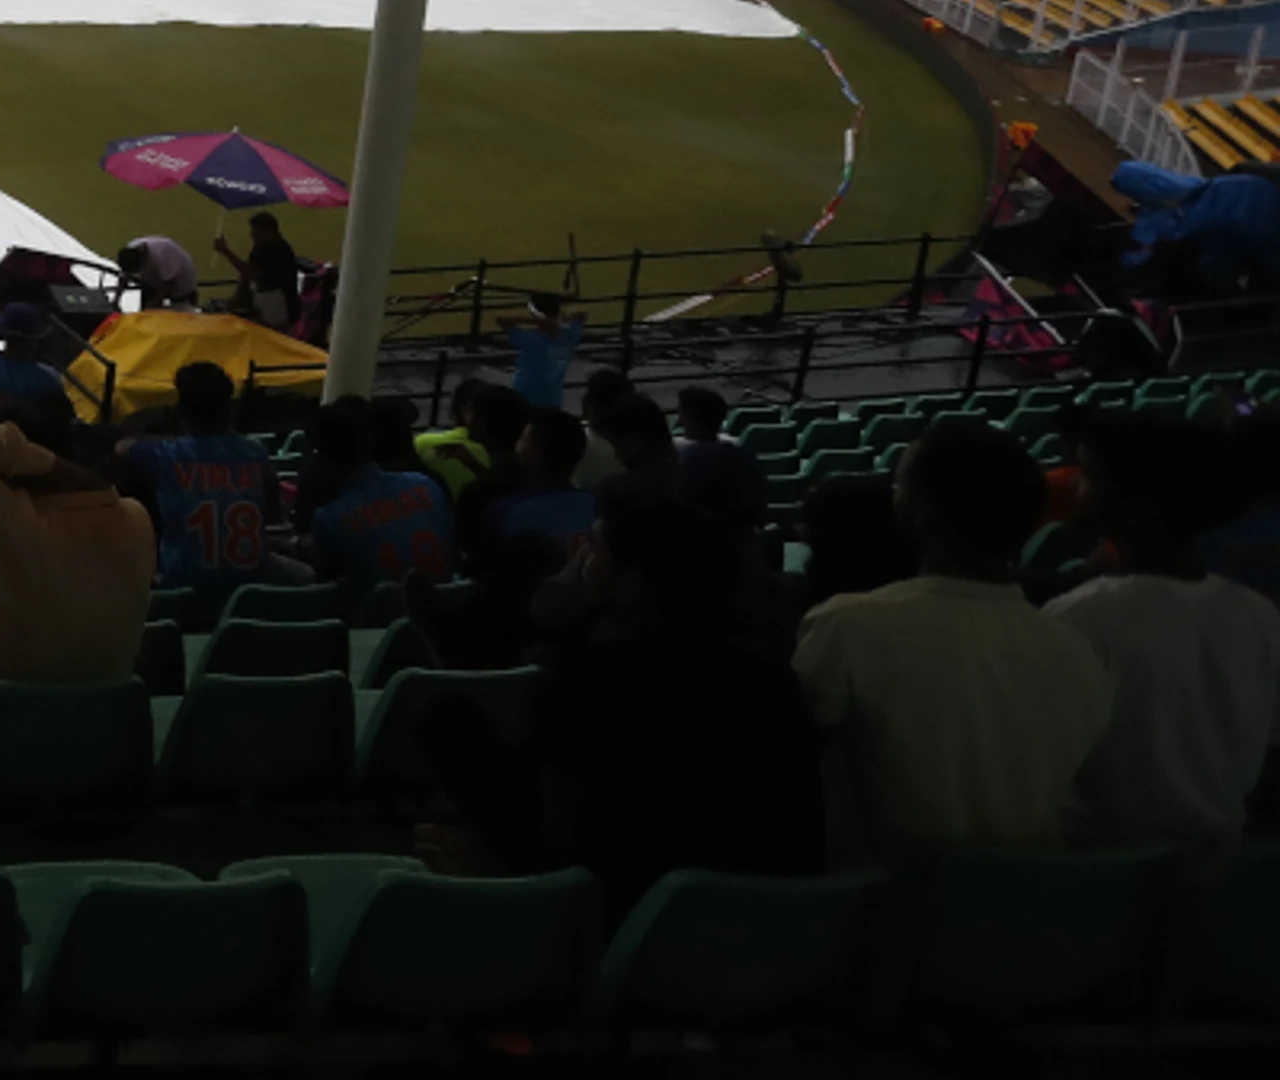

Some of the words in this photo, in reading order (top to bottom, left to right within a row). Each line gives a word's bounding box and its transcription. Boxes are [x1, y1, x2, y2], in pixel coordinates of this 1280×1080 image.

[174, 461, 262, 493] VIRAT
[340, 485, 435, 533] VIRAT
[184, 499, 264, 570] 18
